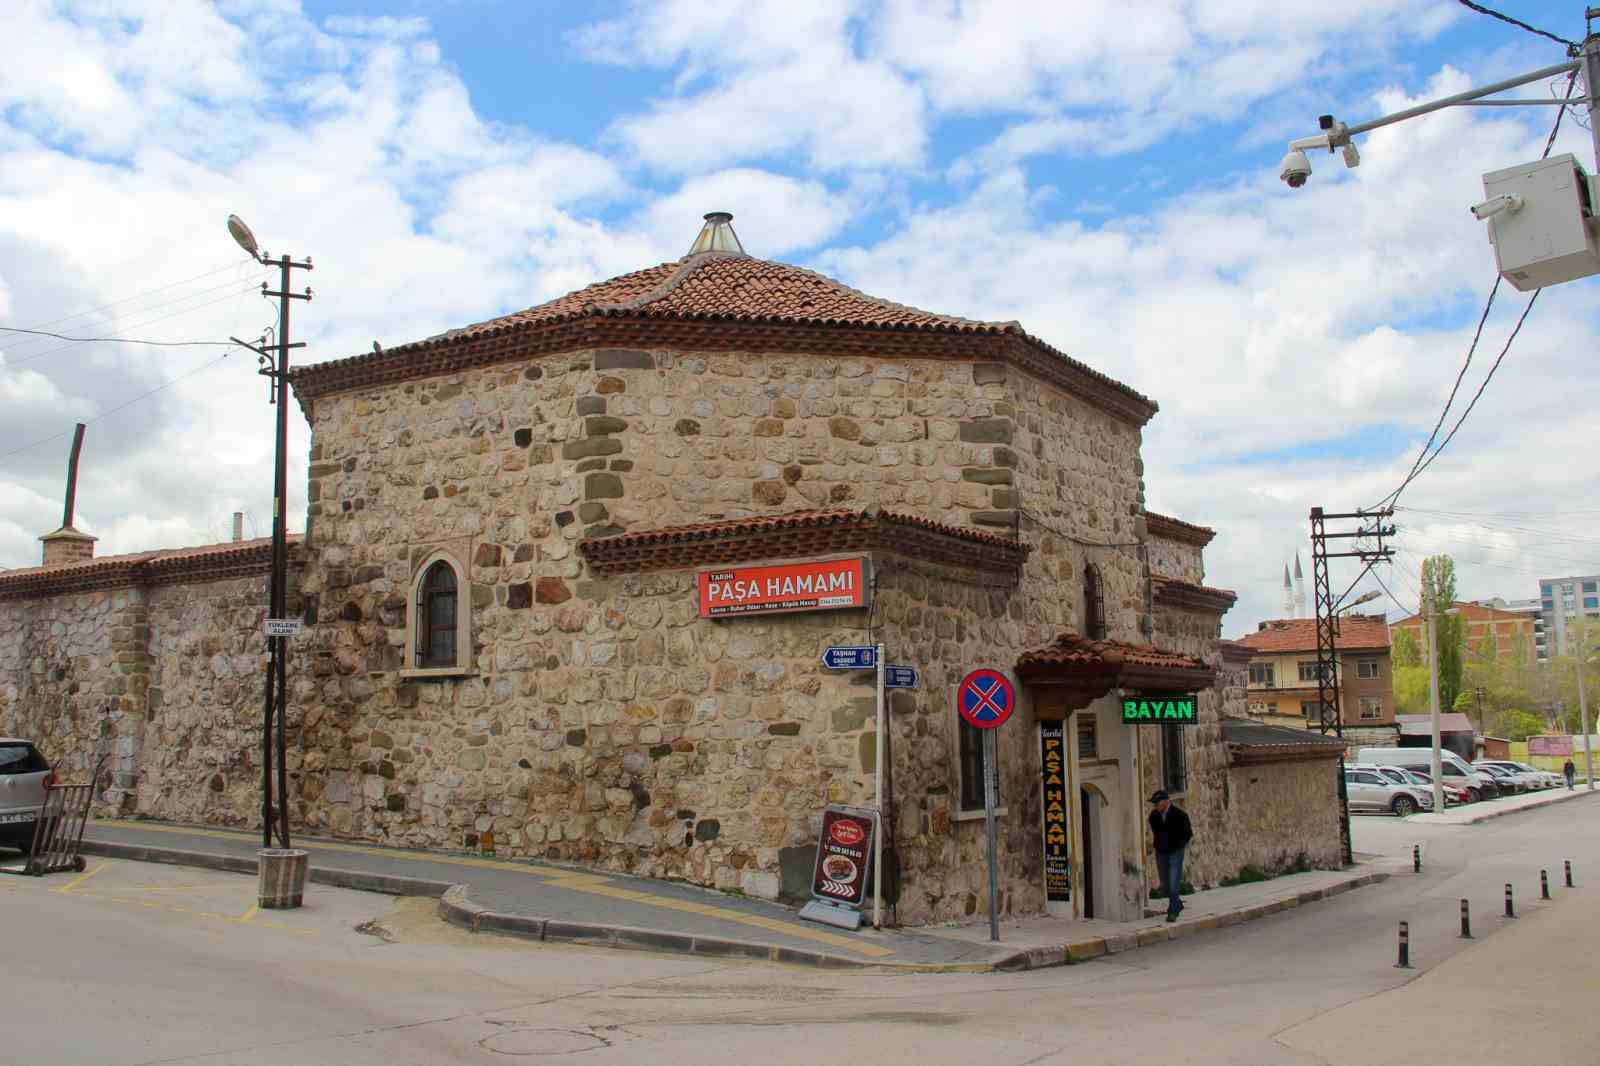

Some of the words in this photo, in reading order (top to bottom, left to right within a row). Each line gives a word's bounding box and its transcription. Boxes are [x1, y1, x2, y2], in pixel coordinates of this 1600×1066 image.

[708, 580, 760, 601] PAŞA
[767, 571, 853, 597] HAMAMI
[1124, 702, 1192, 718] BAYAN
